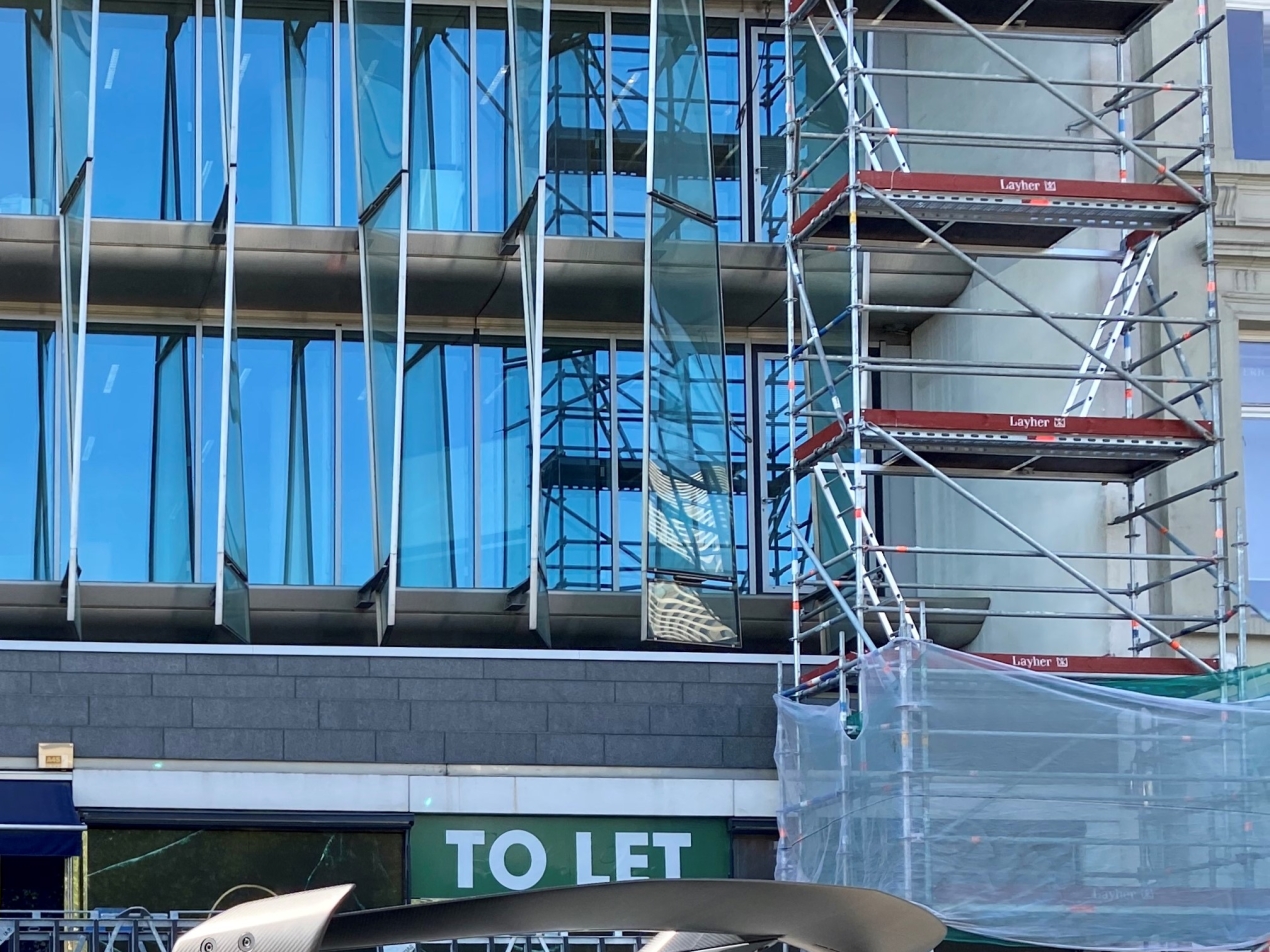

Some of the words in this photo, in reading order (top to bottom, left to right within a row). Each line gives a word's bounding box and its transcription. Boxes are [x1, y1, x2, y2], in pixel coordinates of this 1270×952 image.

[1000, 179, 1040, 191] Layher
[1010, 416, 1049, 429] Layher
[1012, 656, 1052, 668] Layher
[445, 829, 547, 890] TO
[575, 832, 692, 885] LET
